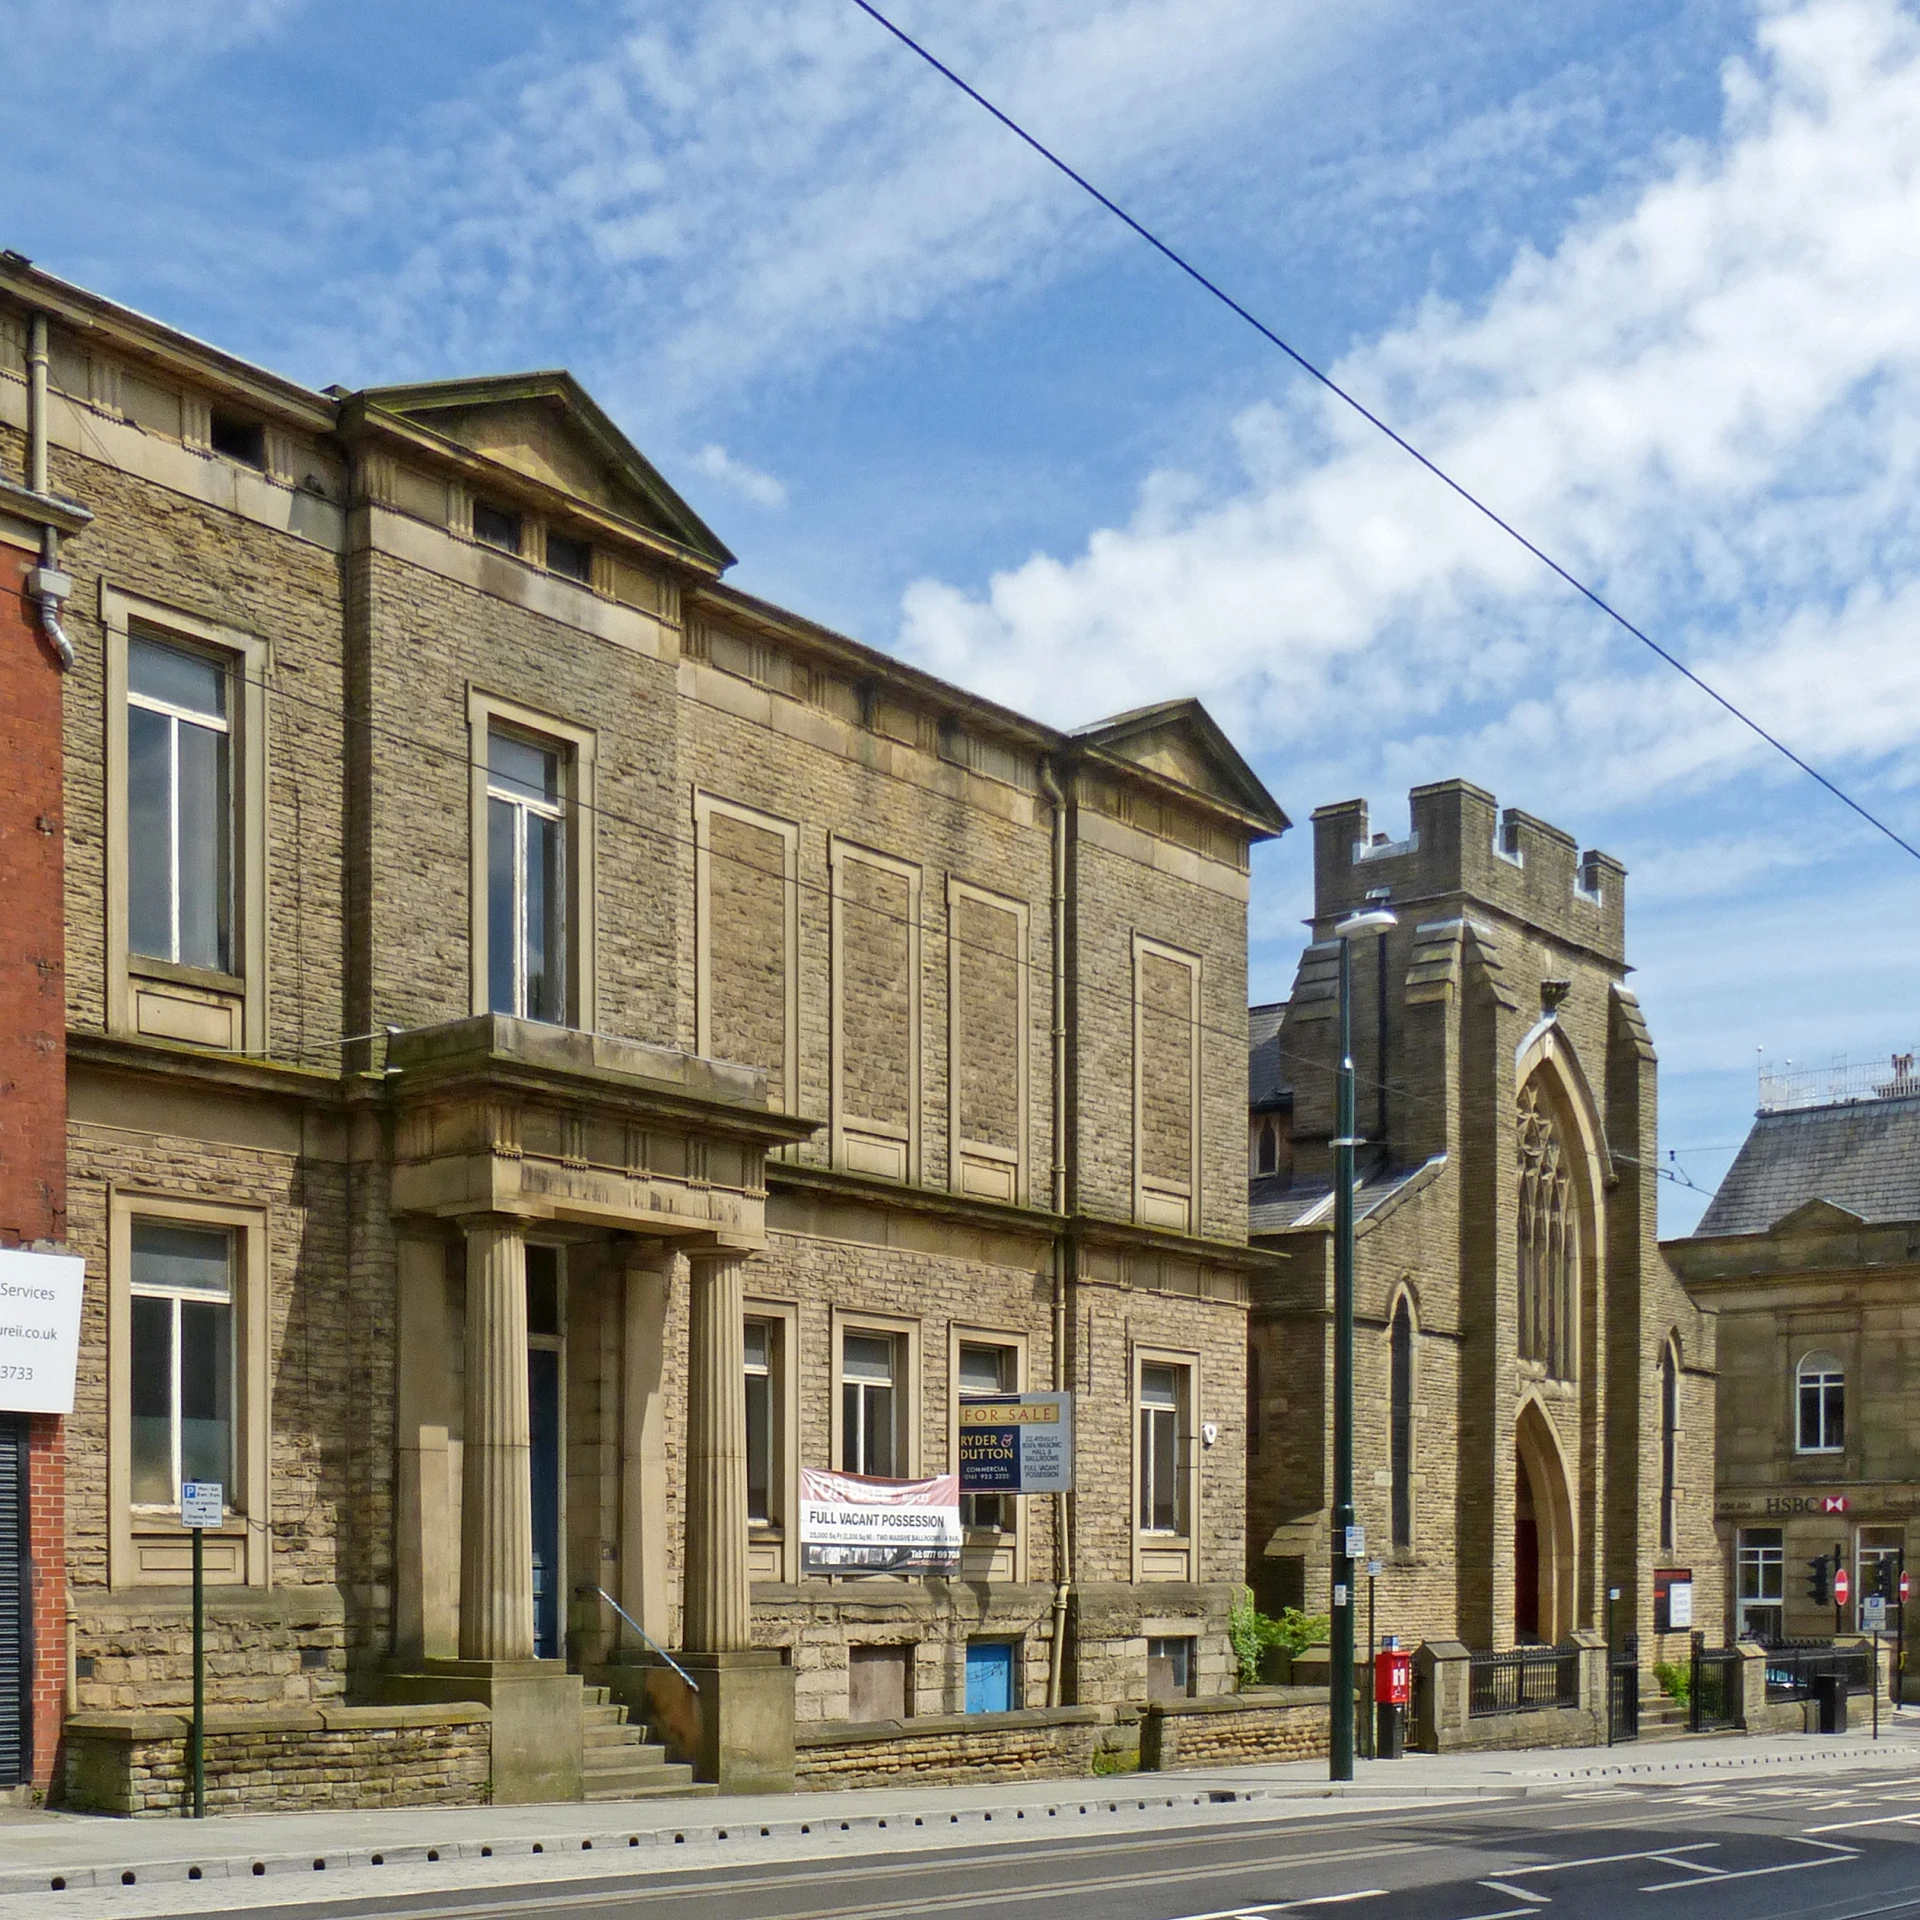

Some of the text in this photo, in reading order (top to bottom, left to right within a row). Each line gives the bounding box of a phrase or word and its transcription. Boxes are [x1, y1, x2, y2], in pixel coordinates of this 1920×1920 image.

[0, 1283, 56, 1301] Services
[0, 1366, 33, 1381] 3733
[964, 1408, 1051, 1421] FOR SALE
[960, 1433, 1013, 1447] RYDER &
[960, 1448, 1013, 1460] DUTTON
[187, 1487, 194, 1496] P
[1766, 1497, 1818, 1513] HSBC
[809, 1511, 944, 1528] FULL VACANT POSSESSION
